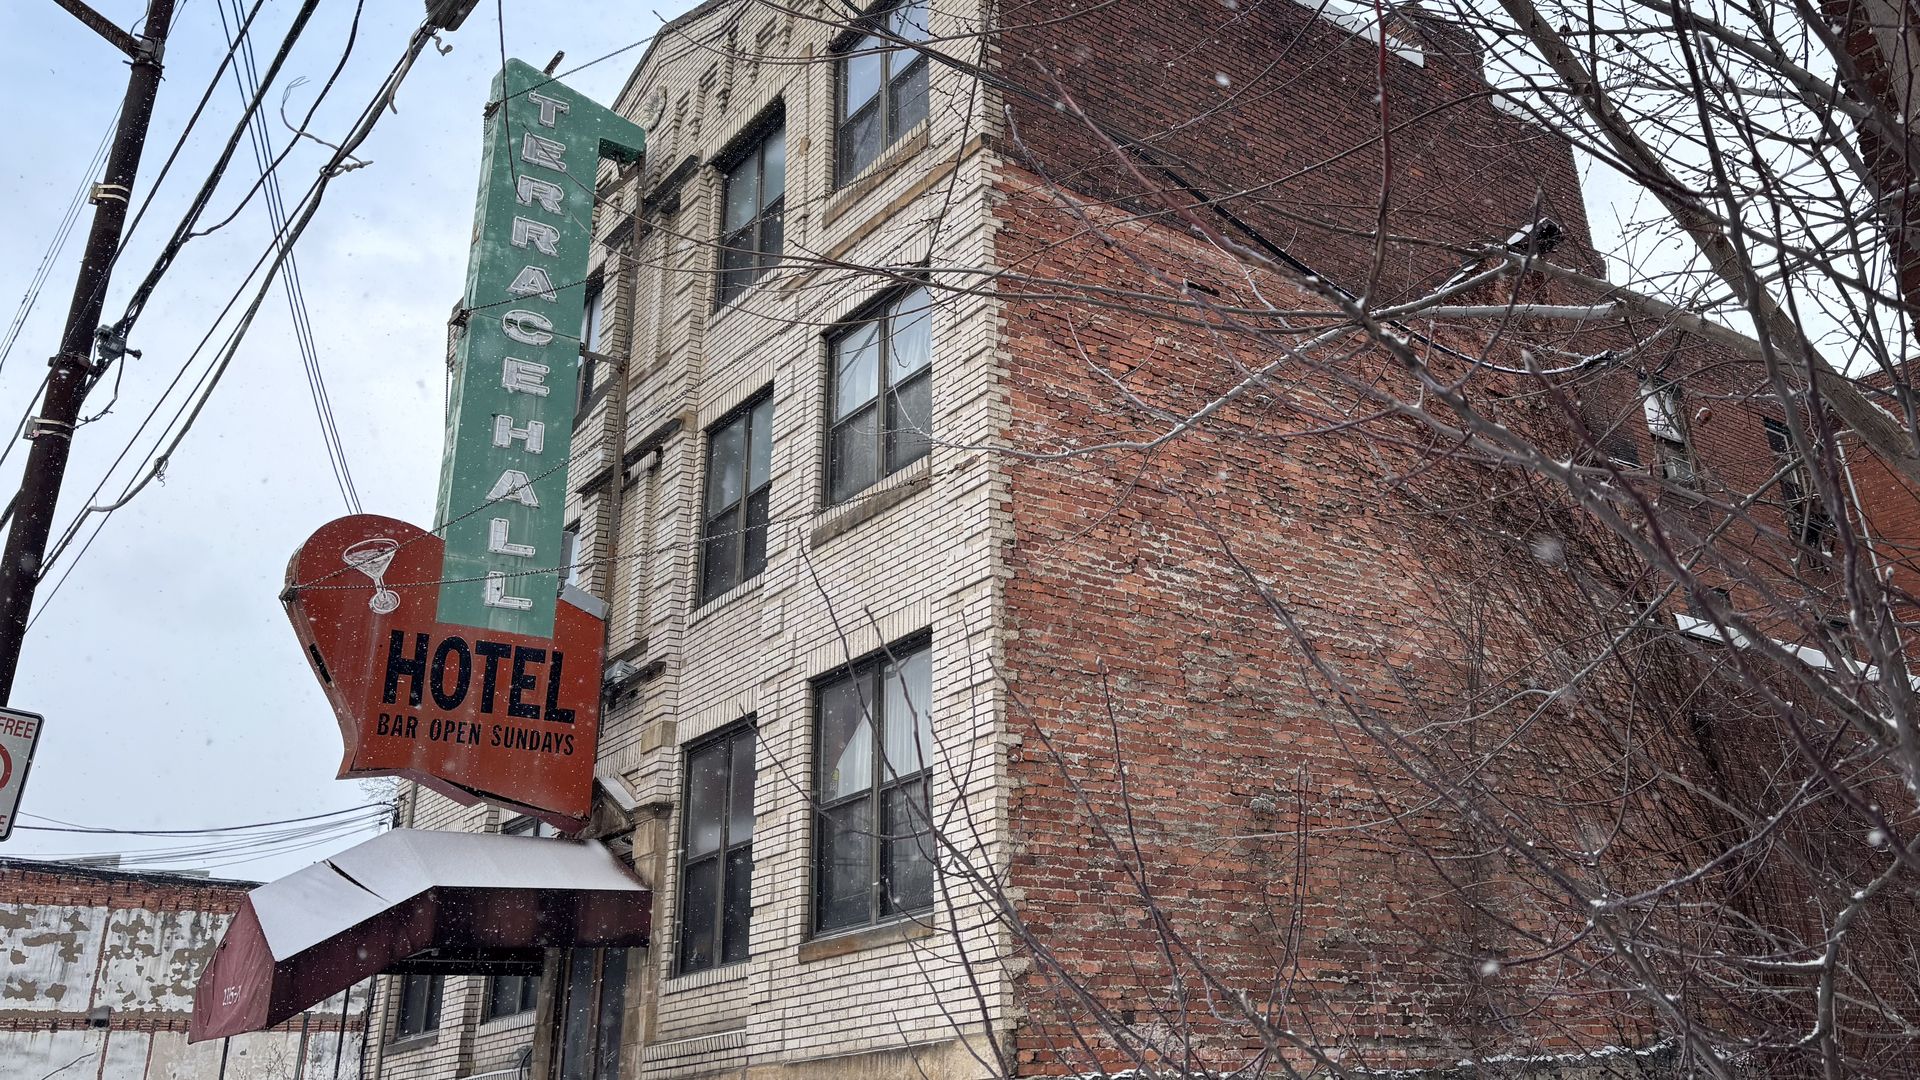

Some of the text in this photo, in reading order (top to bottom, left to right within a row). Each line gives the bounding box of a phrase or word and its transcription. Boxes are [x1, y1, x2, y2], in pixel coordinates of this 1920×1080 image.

[484, 89, 570, 611] TERRACE HALL
[382, 630, 576, 723] HOTEL
[377, 714, 575, 755] BAR OPEN SUNDAYS
